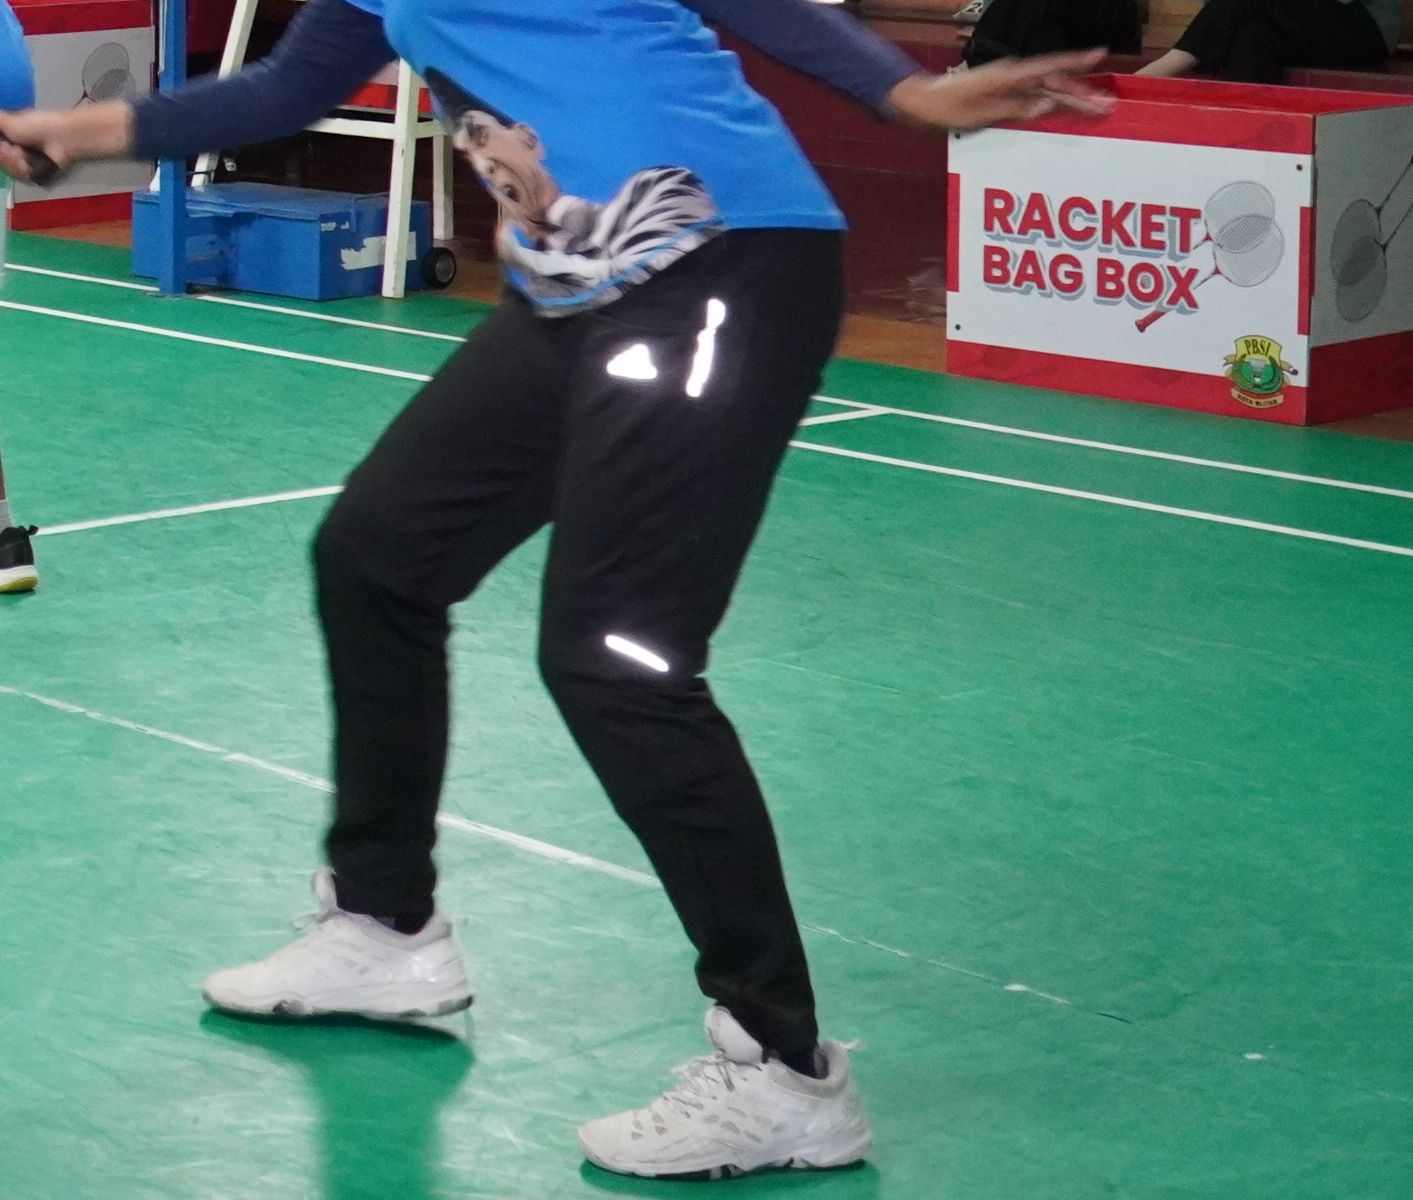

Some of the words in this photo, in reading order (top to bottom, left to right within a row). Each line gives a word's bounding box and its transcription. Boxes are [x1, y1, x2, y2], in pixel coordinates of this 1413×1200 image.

[983, 187, 1202, 254] RACKET
[983, 245, 1084, 294] BAG
[1096, 257, 1199, 310] BOX
[1244, 339, 1271, 356] PBSI
